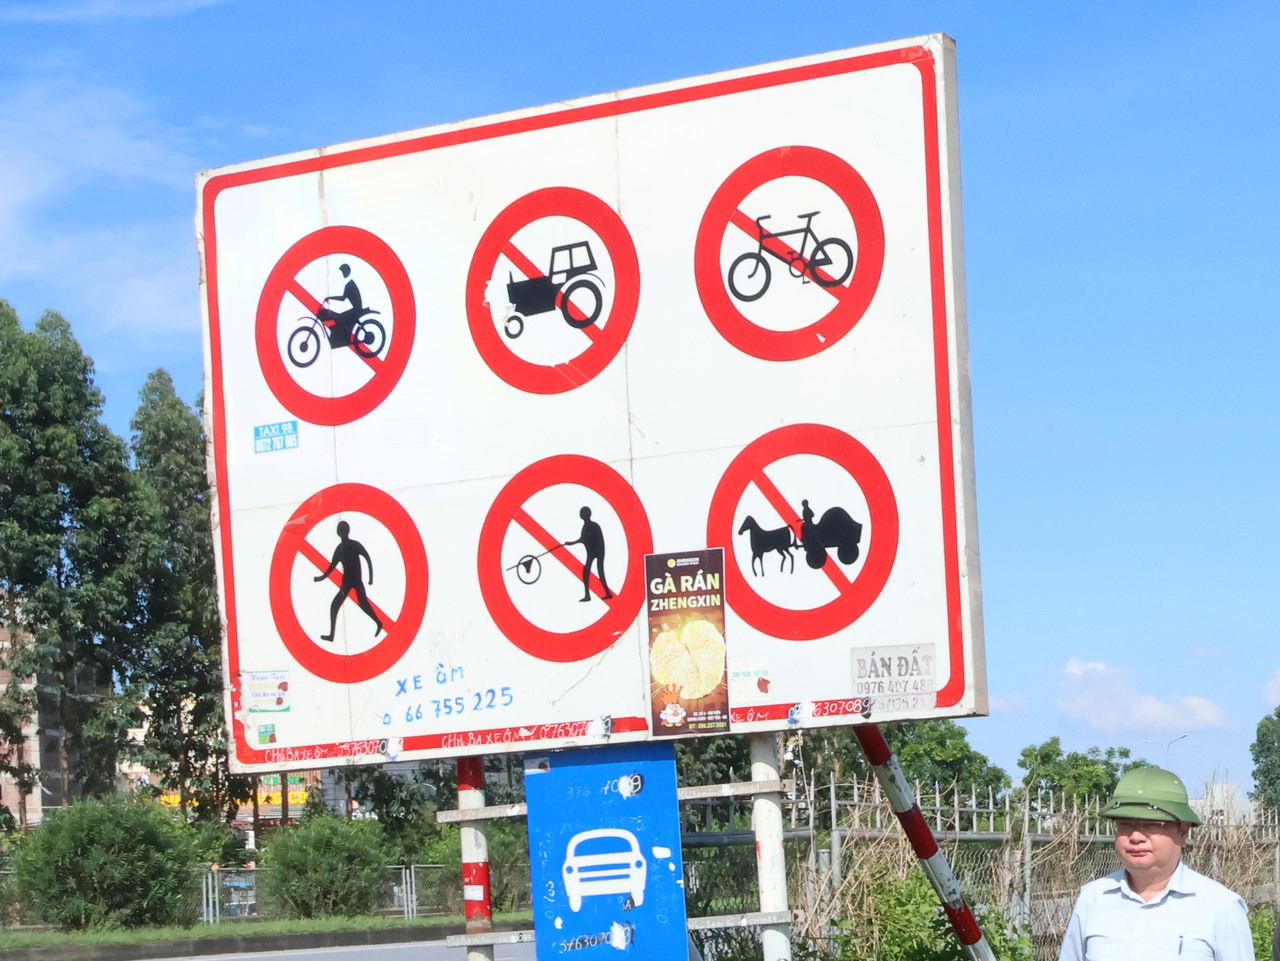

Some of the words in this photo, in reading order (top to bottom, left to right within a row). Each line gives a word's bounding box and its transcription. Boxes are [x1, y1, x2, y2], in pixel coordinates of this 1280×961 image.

[650, 571, 677, 595] GÀ
[680, 568, 721, 593] RÁN
[650, 593, 722, 612] ZHENGXIN
[856, 650, 893, 679] BÁN
[896, 645, 934, 677] ĐẤT
[395, 674, 424, 697] XE
[472, 686, 514, 712] 225
